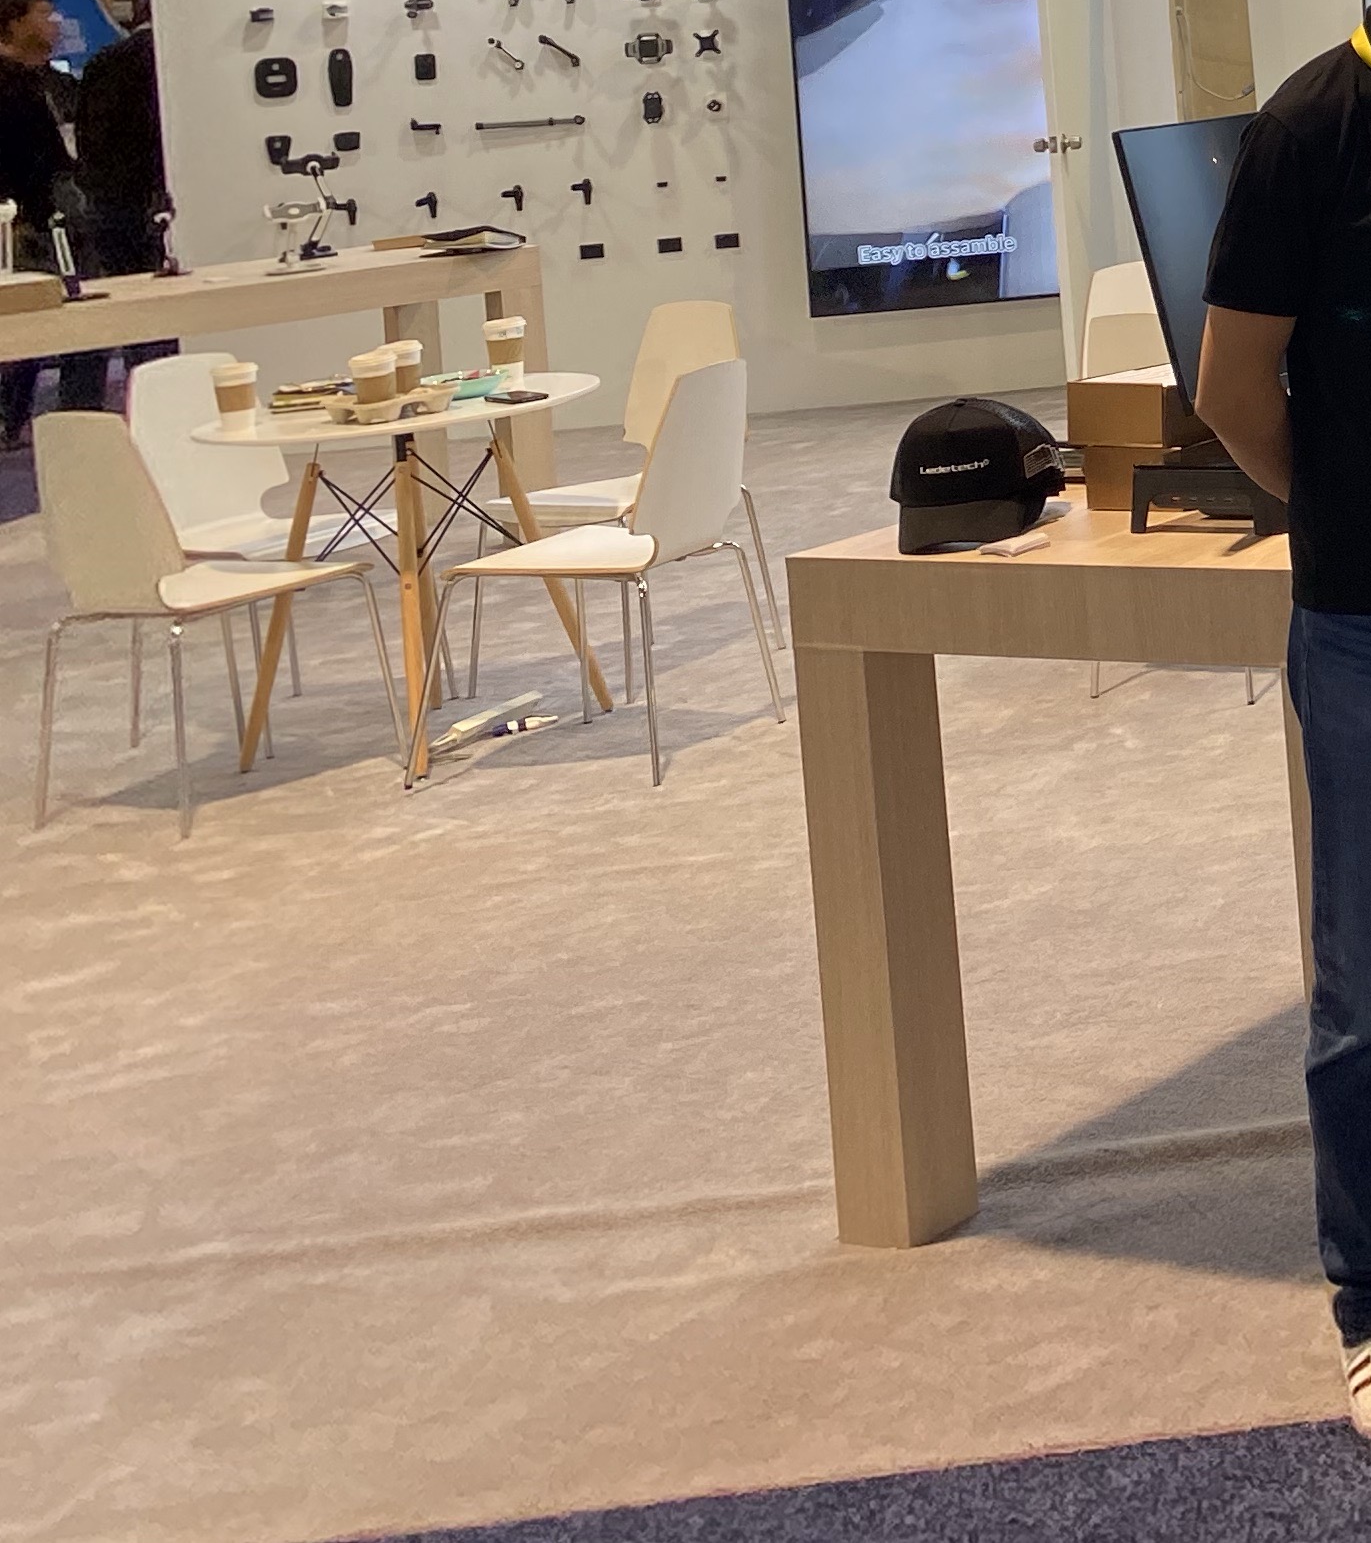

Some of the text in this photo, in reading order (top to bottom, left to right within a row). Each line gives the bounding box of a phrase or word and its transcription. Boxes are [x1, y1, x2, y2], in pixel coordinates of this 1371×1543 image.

[858, 233, 1018, 266] Easy to assamble
